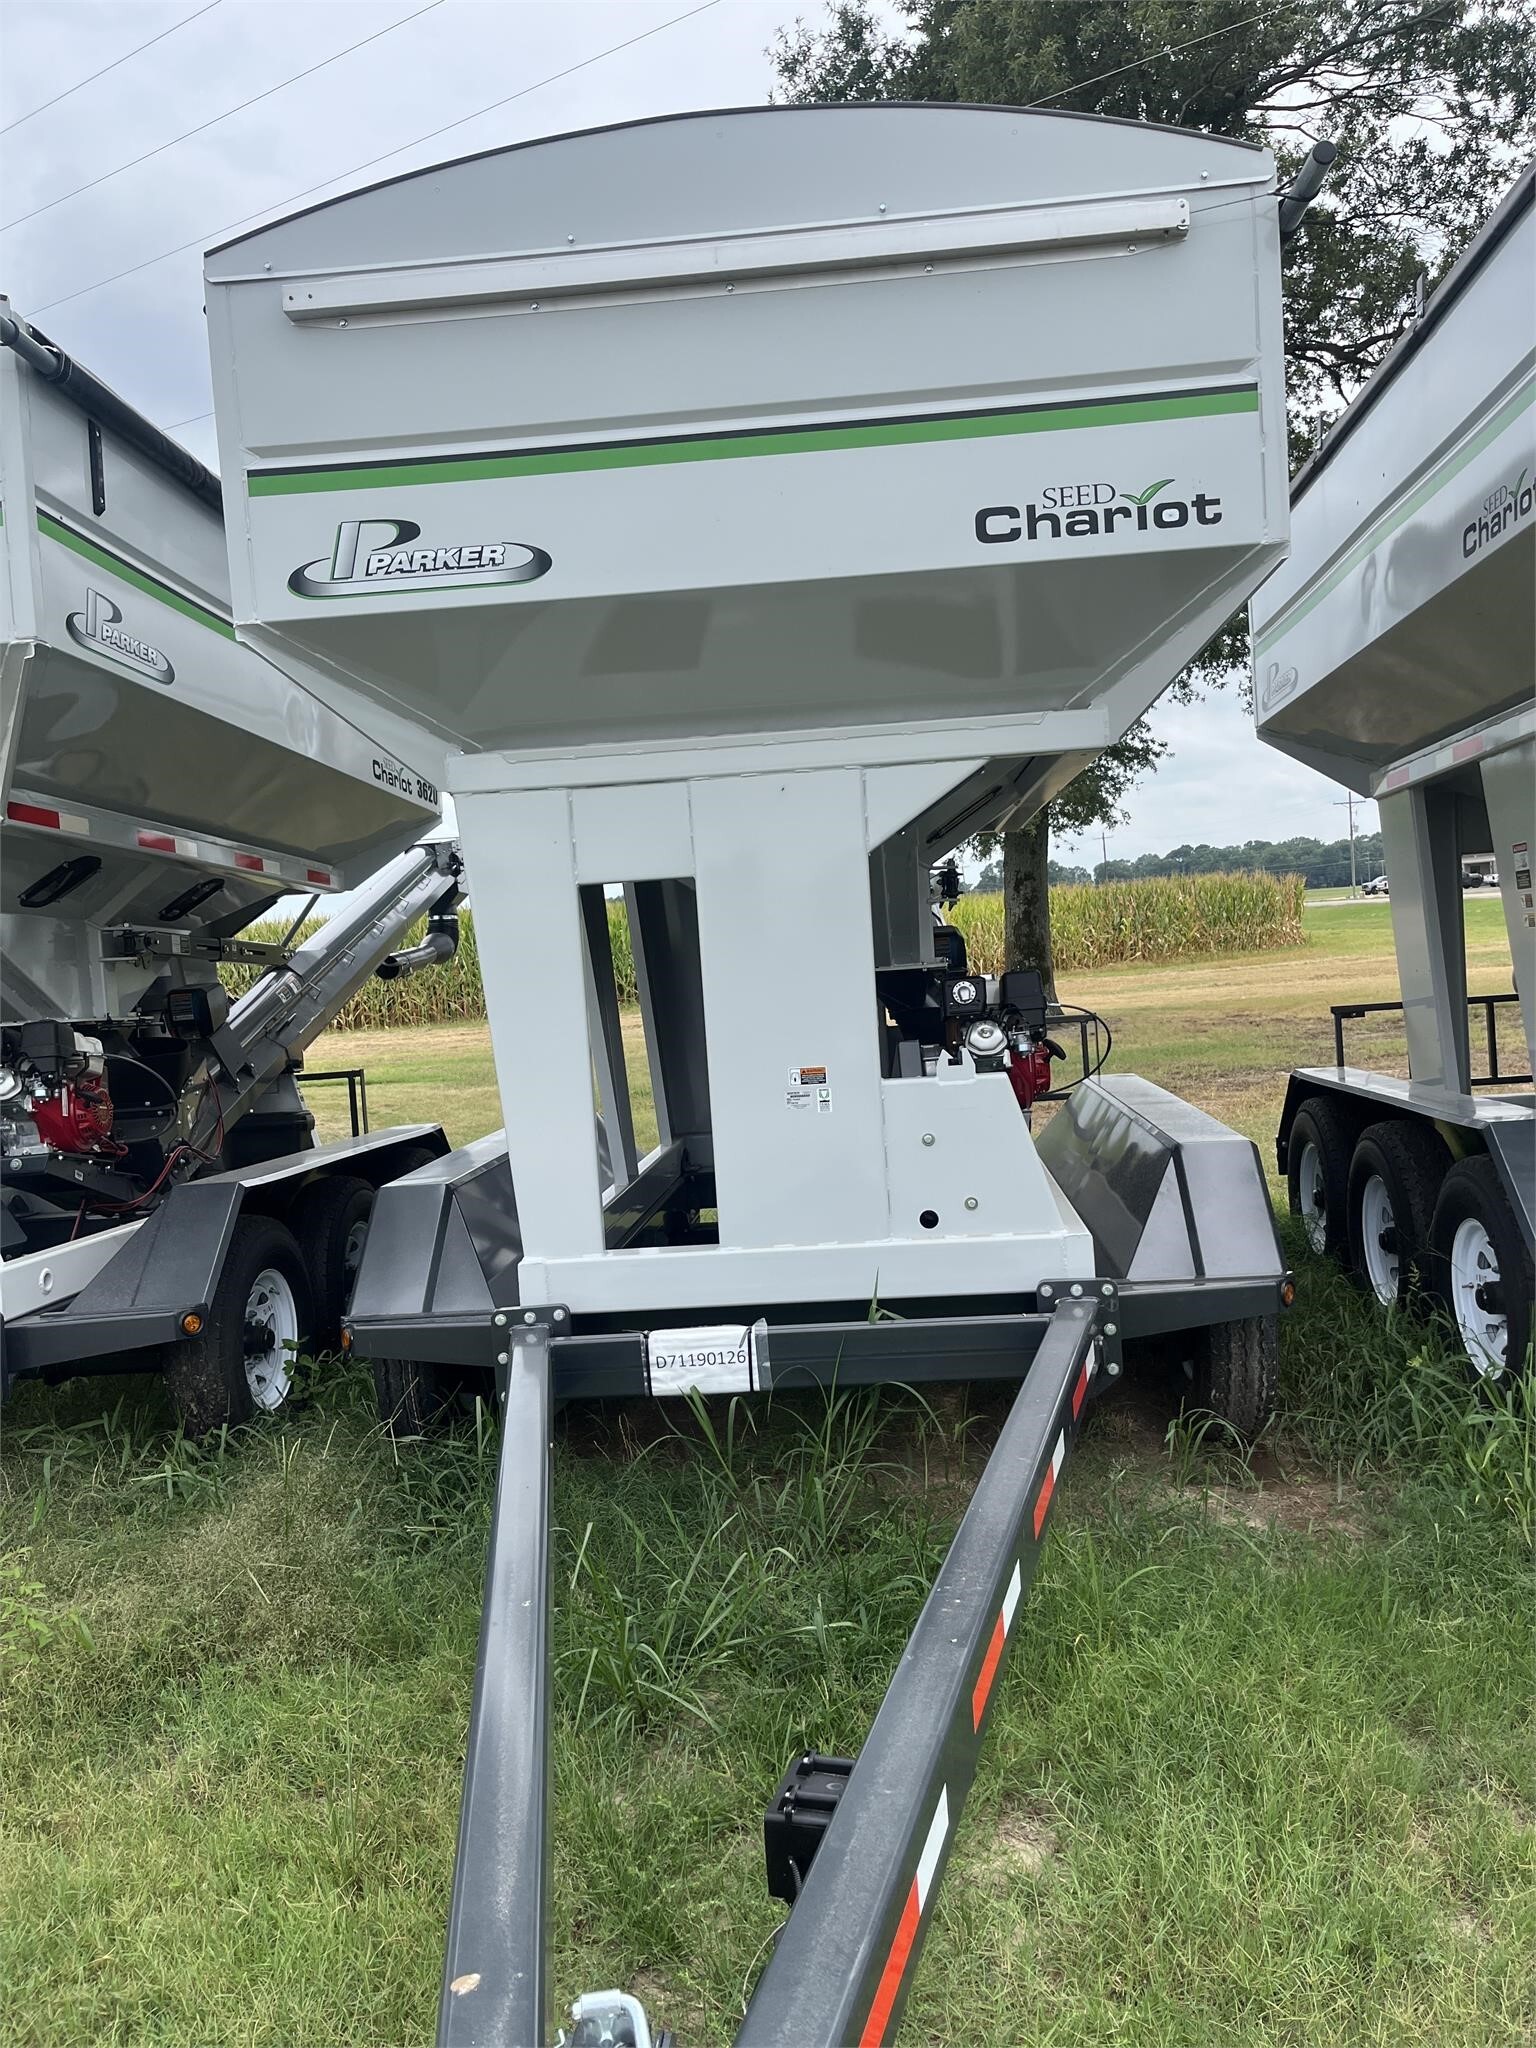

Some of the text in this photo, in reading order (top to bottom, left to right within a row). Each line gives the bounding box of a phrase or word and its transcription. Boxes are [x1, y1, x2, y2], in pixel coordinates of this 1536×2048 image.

[1042, 483, 1116, 509] SEED
[1483, 485, 1508, 518] SEED
[974, 493, 1222, 544] Chariot
[366, 543, 506, 577] PARKER
[101, 623, 157, 666] PARKER
[372, 759, 438, 806] Chariot 3620
[655, 1350, 747, 1369] D71190126
